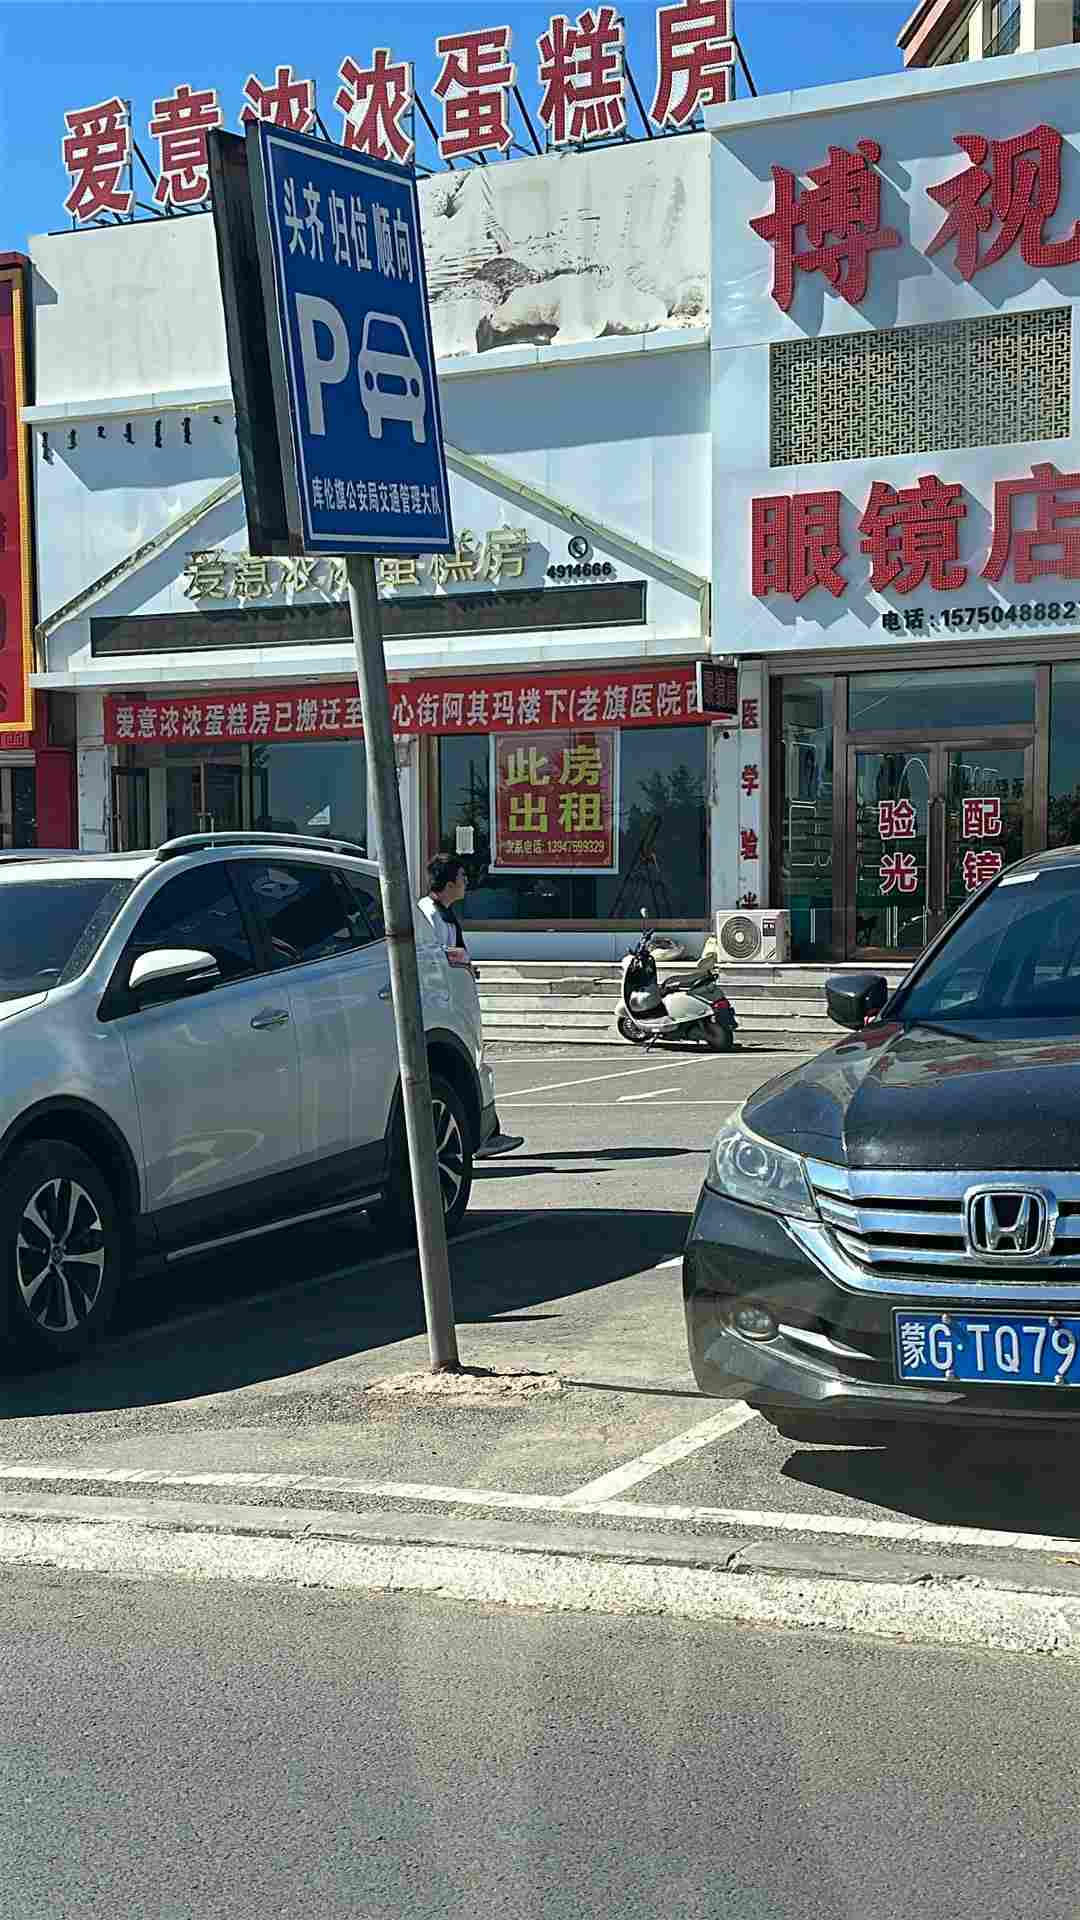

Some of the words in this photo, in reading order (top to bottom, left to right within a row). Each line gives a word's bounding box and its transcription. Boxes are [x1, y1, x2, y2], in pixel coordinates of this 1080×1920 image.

[284, 177, 324, 262] 头齐
[328, 189, 372, 272] 归位
[371, 203, 414, 283] 顺向
[295, 292, 350, 436] P
[311, 477, 441, 515] 库伦旗公安局交通管理大队
[751, 461, 1080, 602] 眼镜店
[547, 562, 612, 578] 4914666
[506, 744, 602, 786] 此房
[508, 792, 604, 833] 出租
